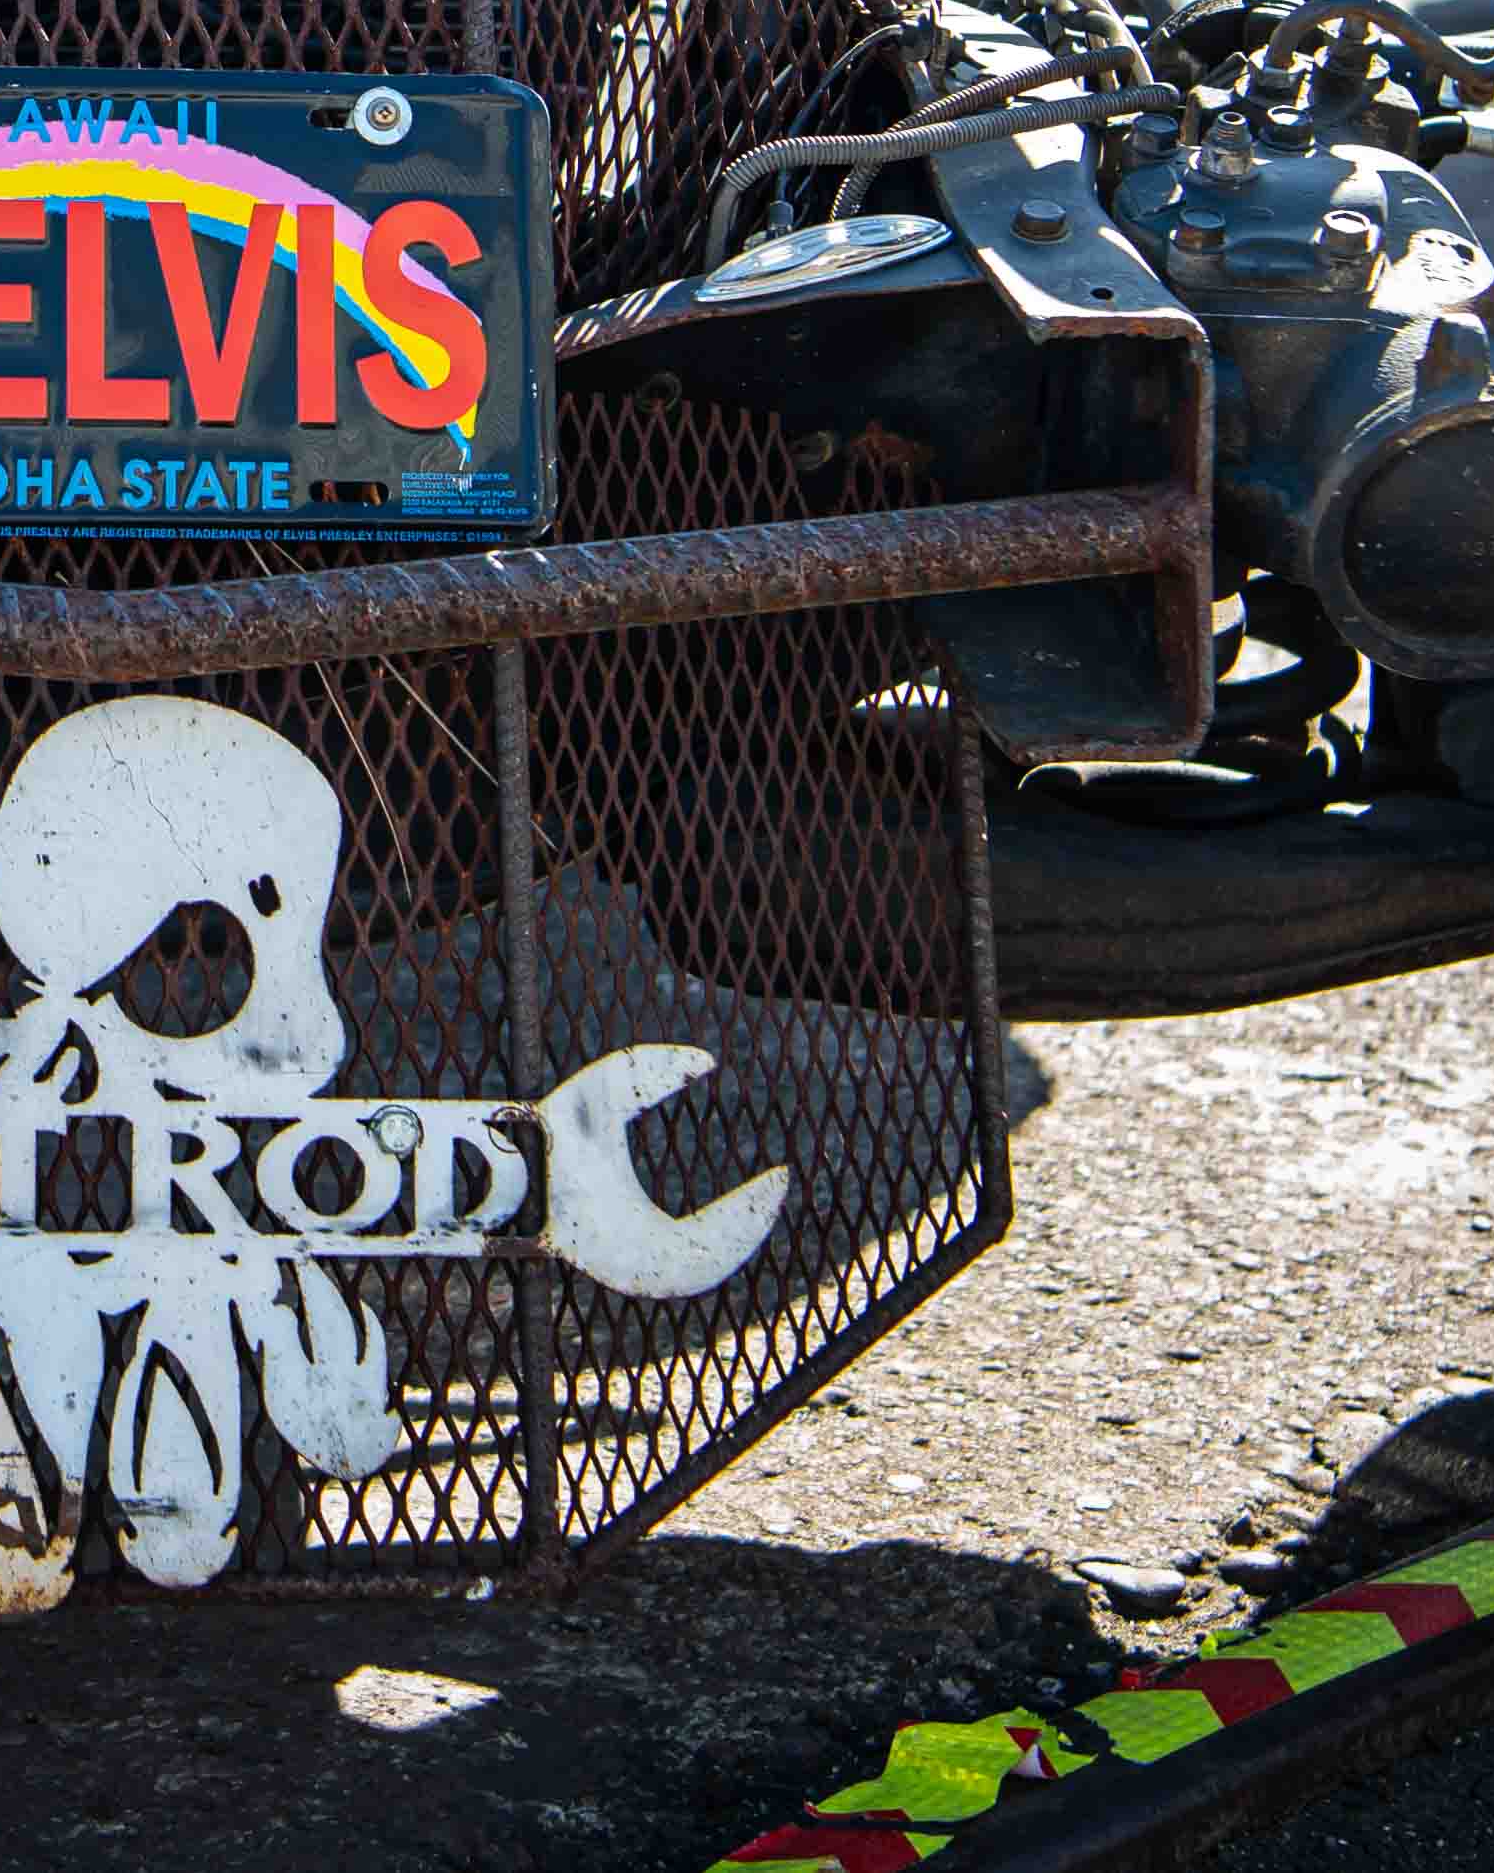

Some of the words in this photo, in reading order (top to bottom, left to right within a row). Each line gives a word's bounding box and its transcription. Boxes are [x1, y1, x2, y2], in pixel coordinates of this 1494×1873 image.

[122, 458, 290, 511] STATE
[15, 526, 67, 537] PRESLEY
[73, 527, 98, 538] ARE
[100, 527, 176, 539] REGISTERED
[264, 529, 281, 540] OF
[132, 1118, 530, 1233] ROD
